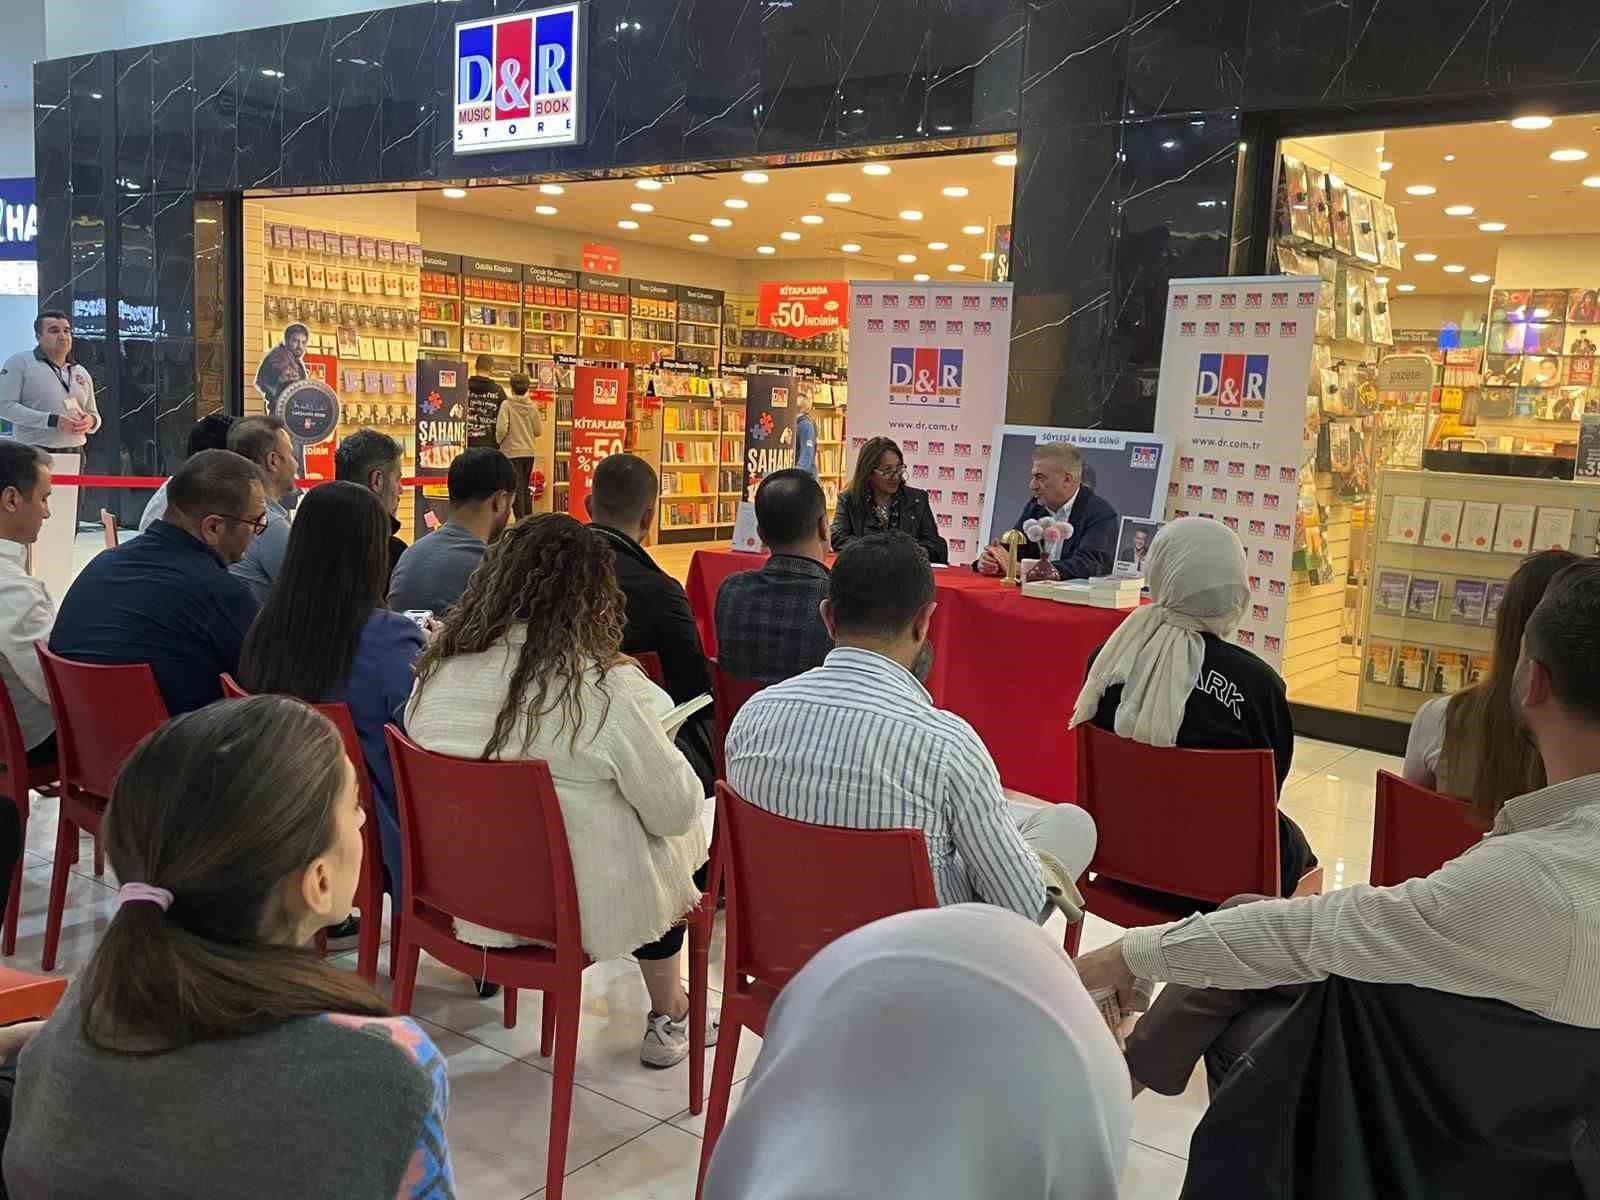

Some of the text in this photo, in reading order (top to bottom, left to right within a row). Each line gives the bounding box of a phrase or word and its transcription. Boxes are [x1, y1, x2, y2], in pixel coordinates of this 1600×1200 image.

[459, 43, 566, 112] D&R
[458, 99, 569, 123] MUSIC BOOK
[457, 118, 571, 141] STORE
[892, 363, 958, 393] D&R
[1199, 371, 1264, 405] D&R
[889, 419, 959, 432] www.dr.com.tr
[1192, 436, 1261, 449] www.dr.com.tr
